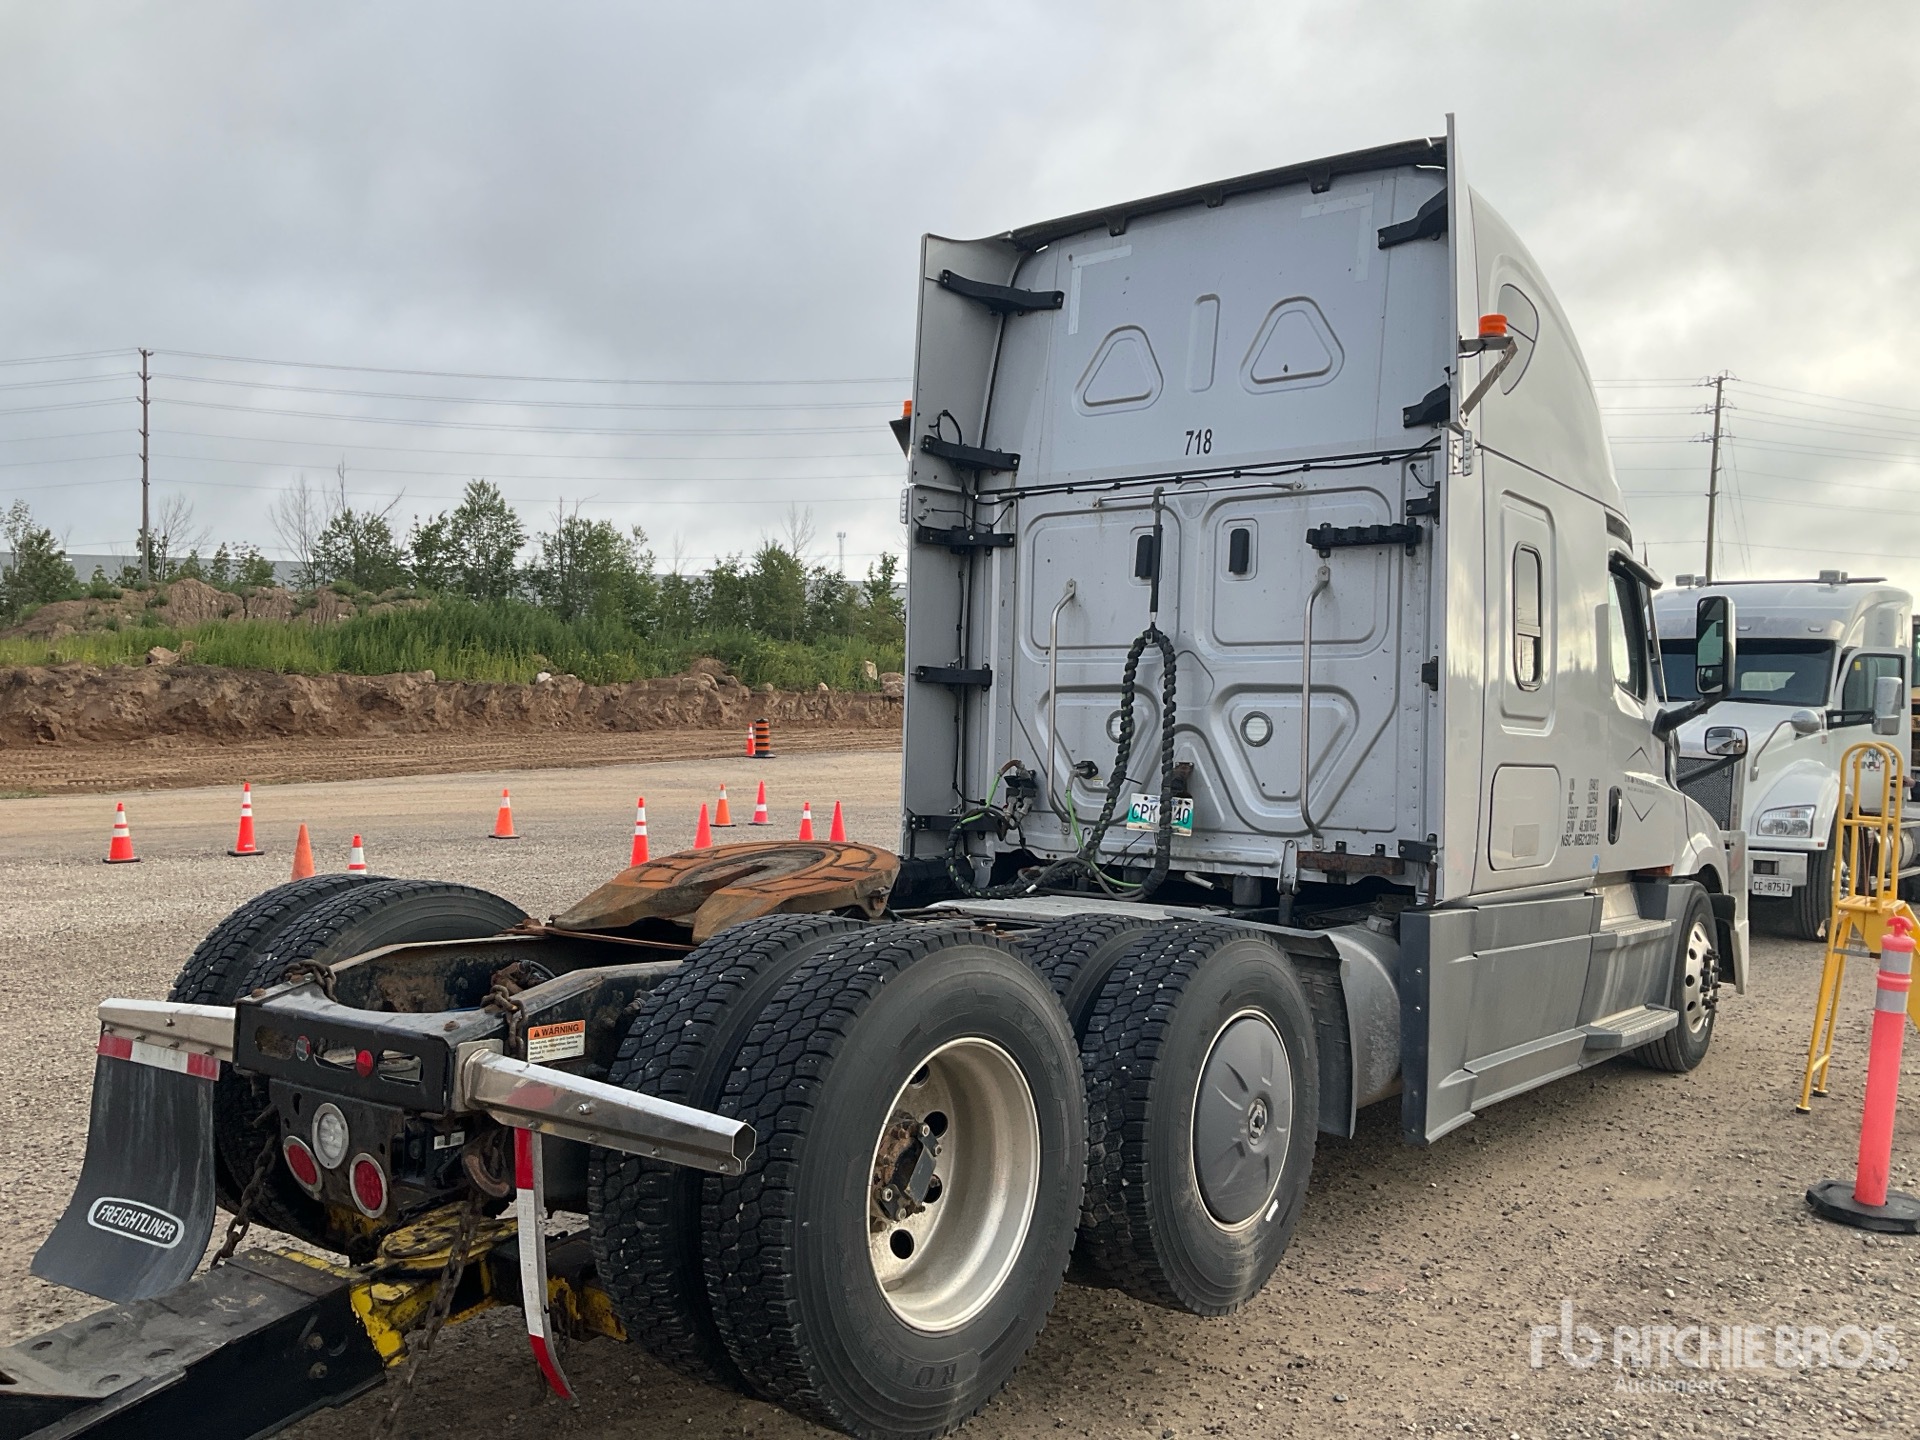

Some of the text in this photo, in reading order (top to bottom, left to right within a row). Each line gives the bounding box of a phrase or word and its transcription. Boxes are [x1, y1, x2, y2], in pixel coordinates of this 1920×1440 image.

[1185, 428, 1213, 456] 718
[1131, 803, 1158, 824] CPK
[1767, 882, 1791, 892] 87517
[541, 1024, 579, 1036] WARNING
[95, 1204, 176, 1241] FREIGHTLINER
